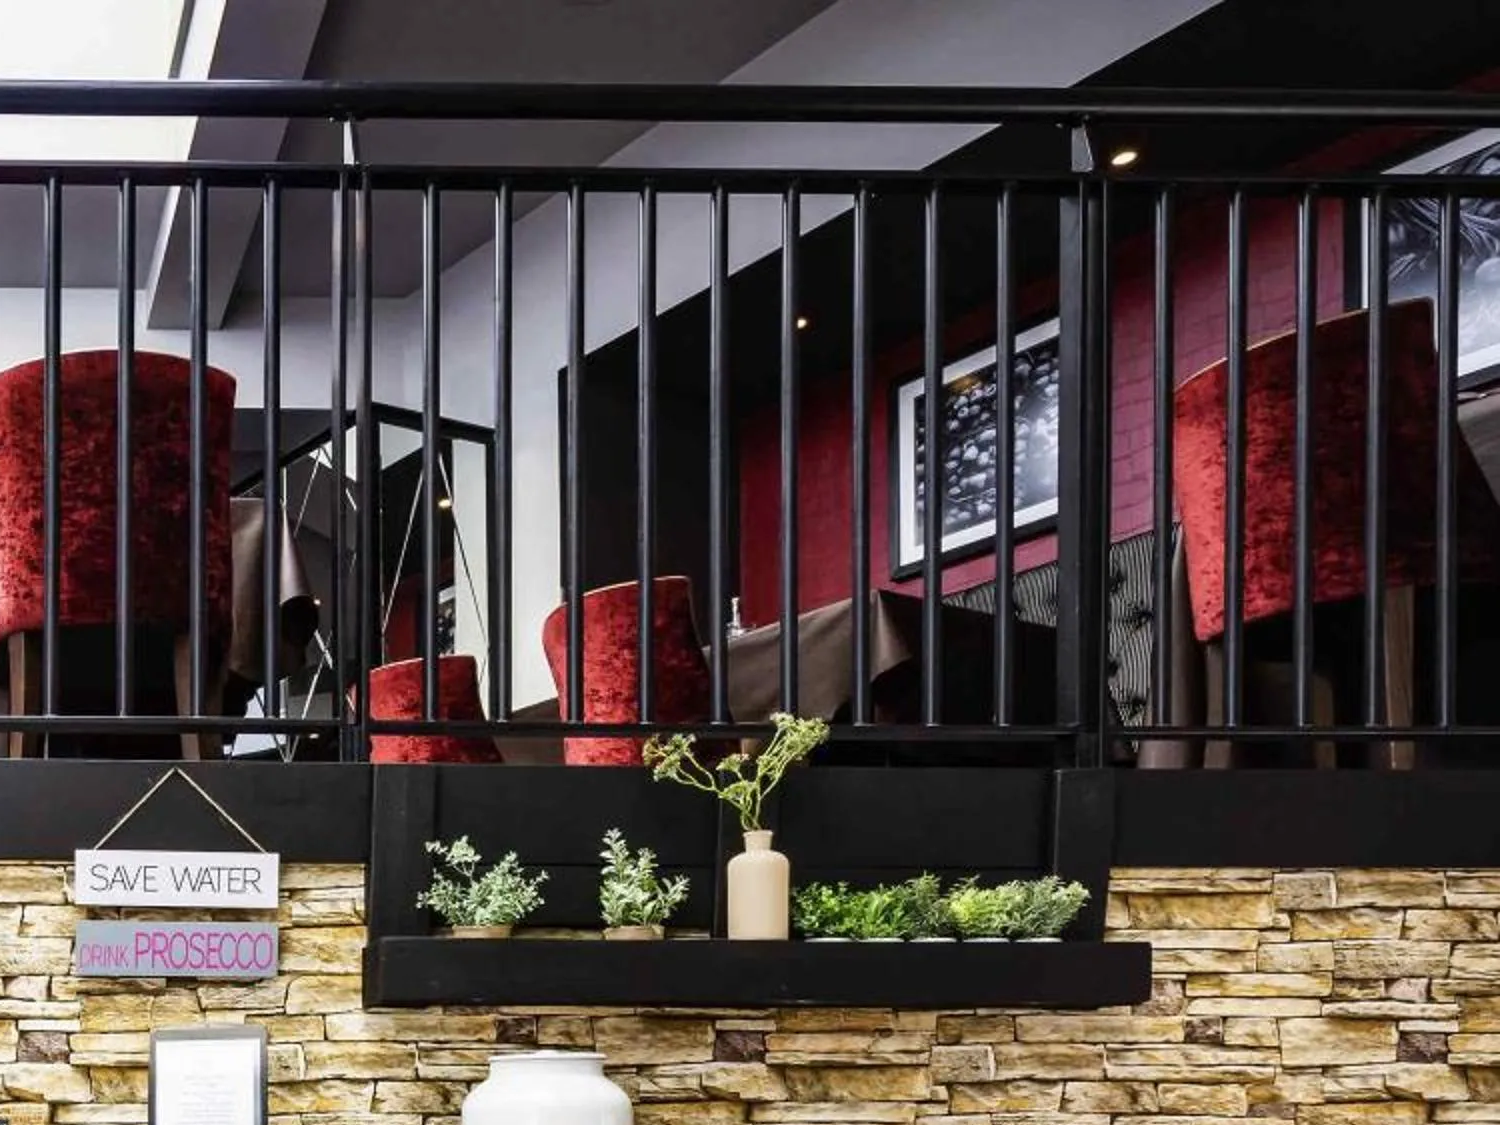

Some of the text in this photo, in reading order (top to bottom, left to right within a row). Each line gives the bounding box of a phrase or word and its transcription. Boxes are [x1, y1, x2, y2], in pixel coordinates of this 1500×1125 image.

[89, 863, 262, 894] SAVE WATER
[79, 930, 274, 970] DRINK PROSECCO
